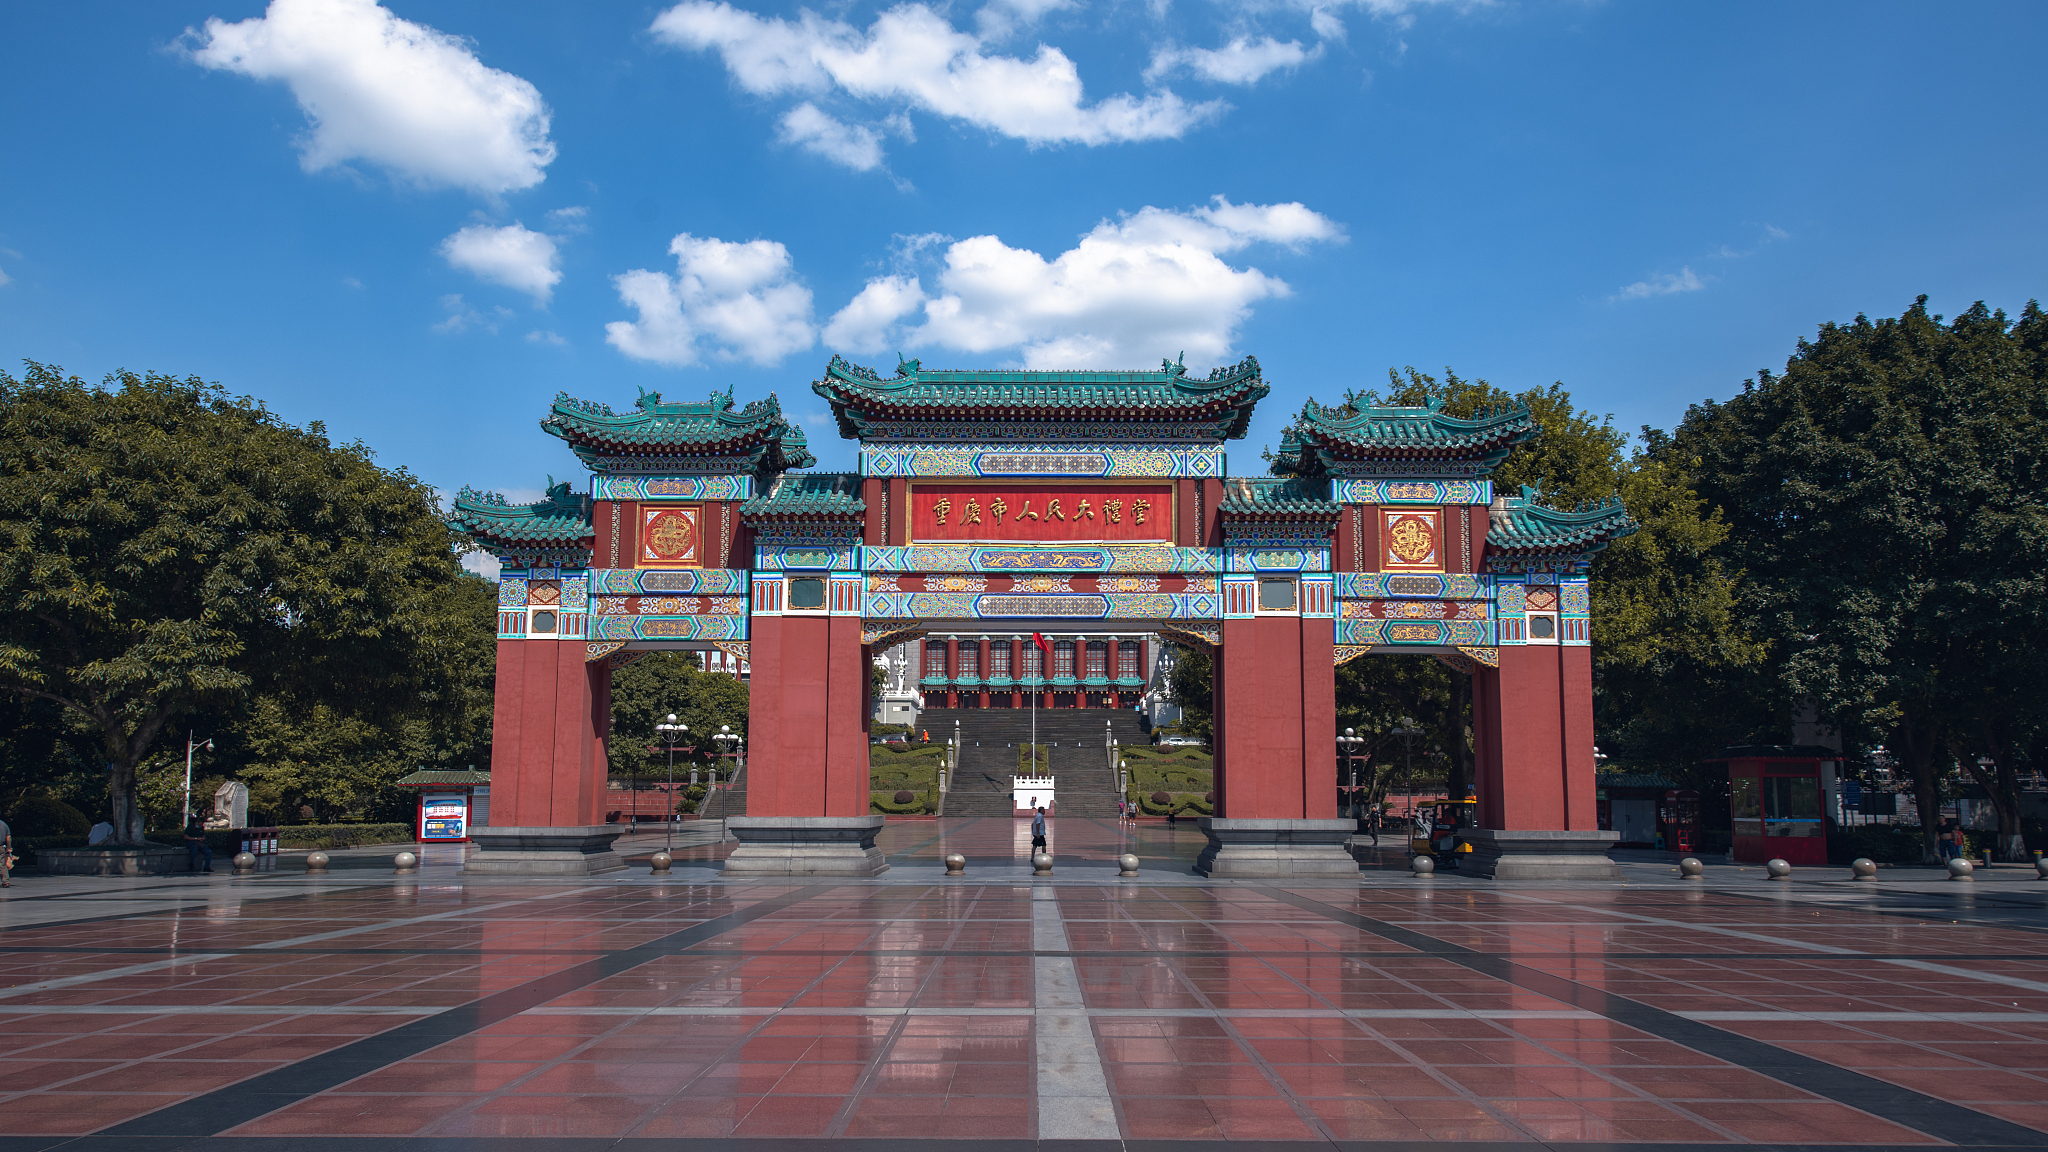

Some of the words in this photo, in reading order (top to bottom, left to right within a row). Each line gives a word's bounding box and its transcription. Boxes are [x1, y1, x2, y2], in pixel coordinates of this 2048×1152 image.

[932, 497, 1151, 526] 重慶市人民大禮堂
